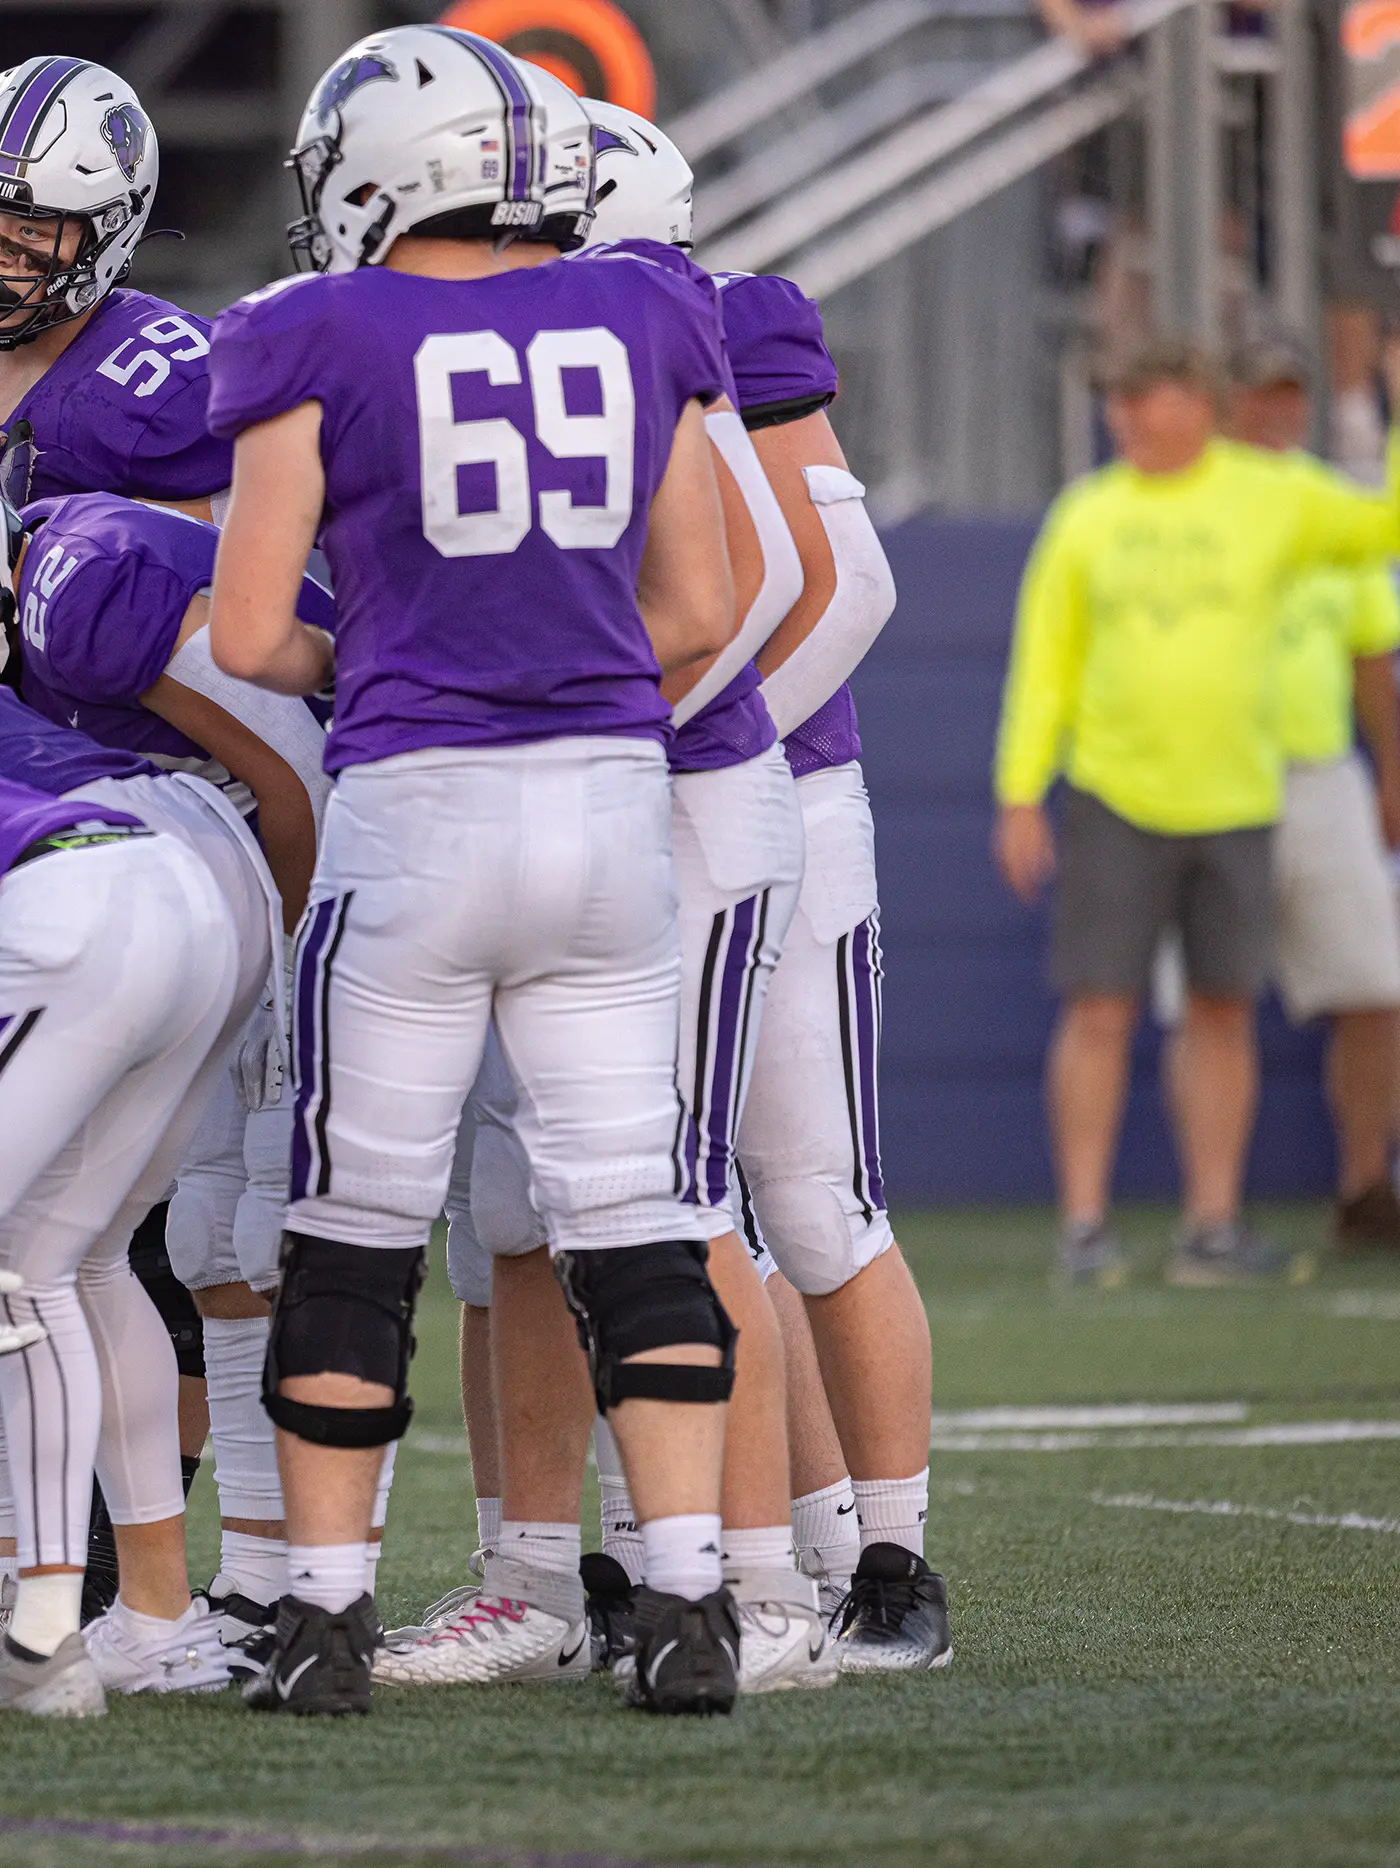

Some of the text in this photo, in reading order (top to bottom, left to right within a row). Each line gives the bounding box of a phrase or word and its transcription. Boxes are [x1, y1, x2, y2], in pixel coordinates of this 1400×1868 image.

[96, 316, 210, 397] 59
[413, 326, 636, 558] 69
[23, 545, 78, 653] 22
[614, 1521, 637, 1532] PU
